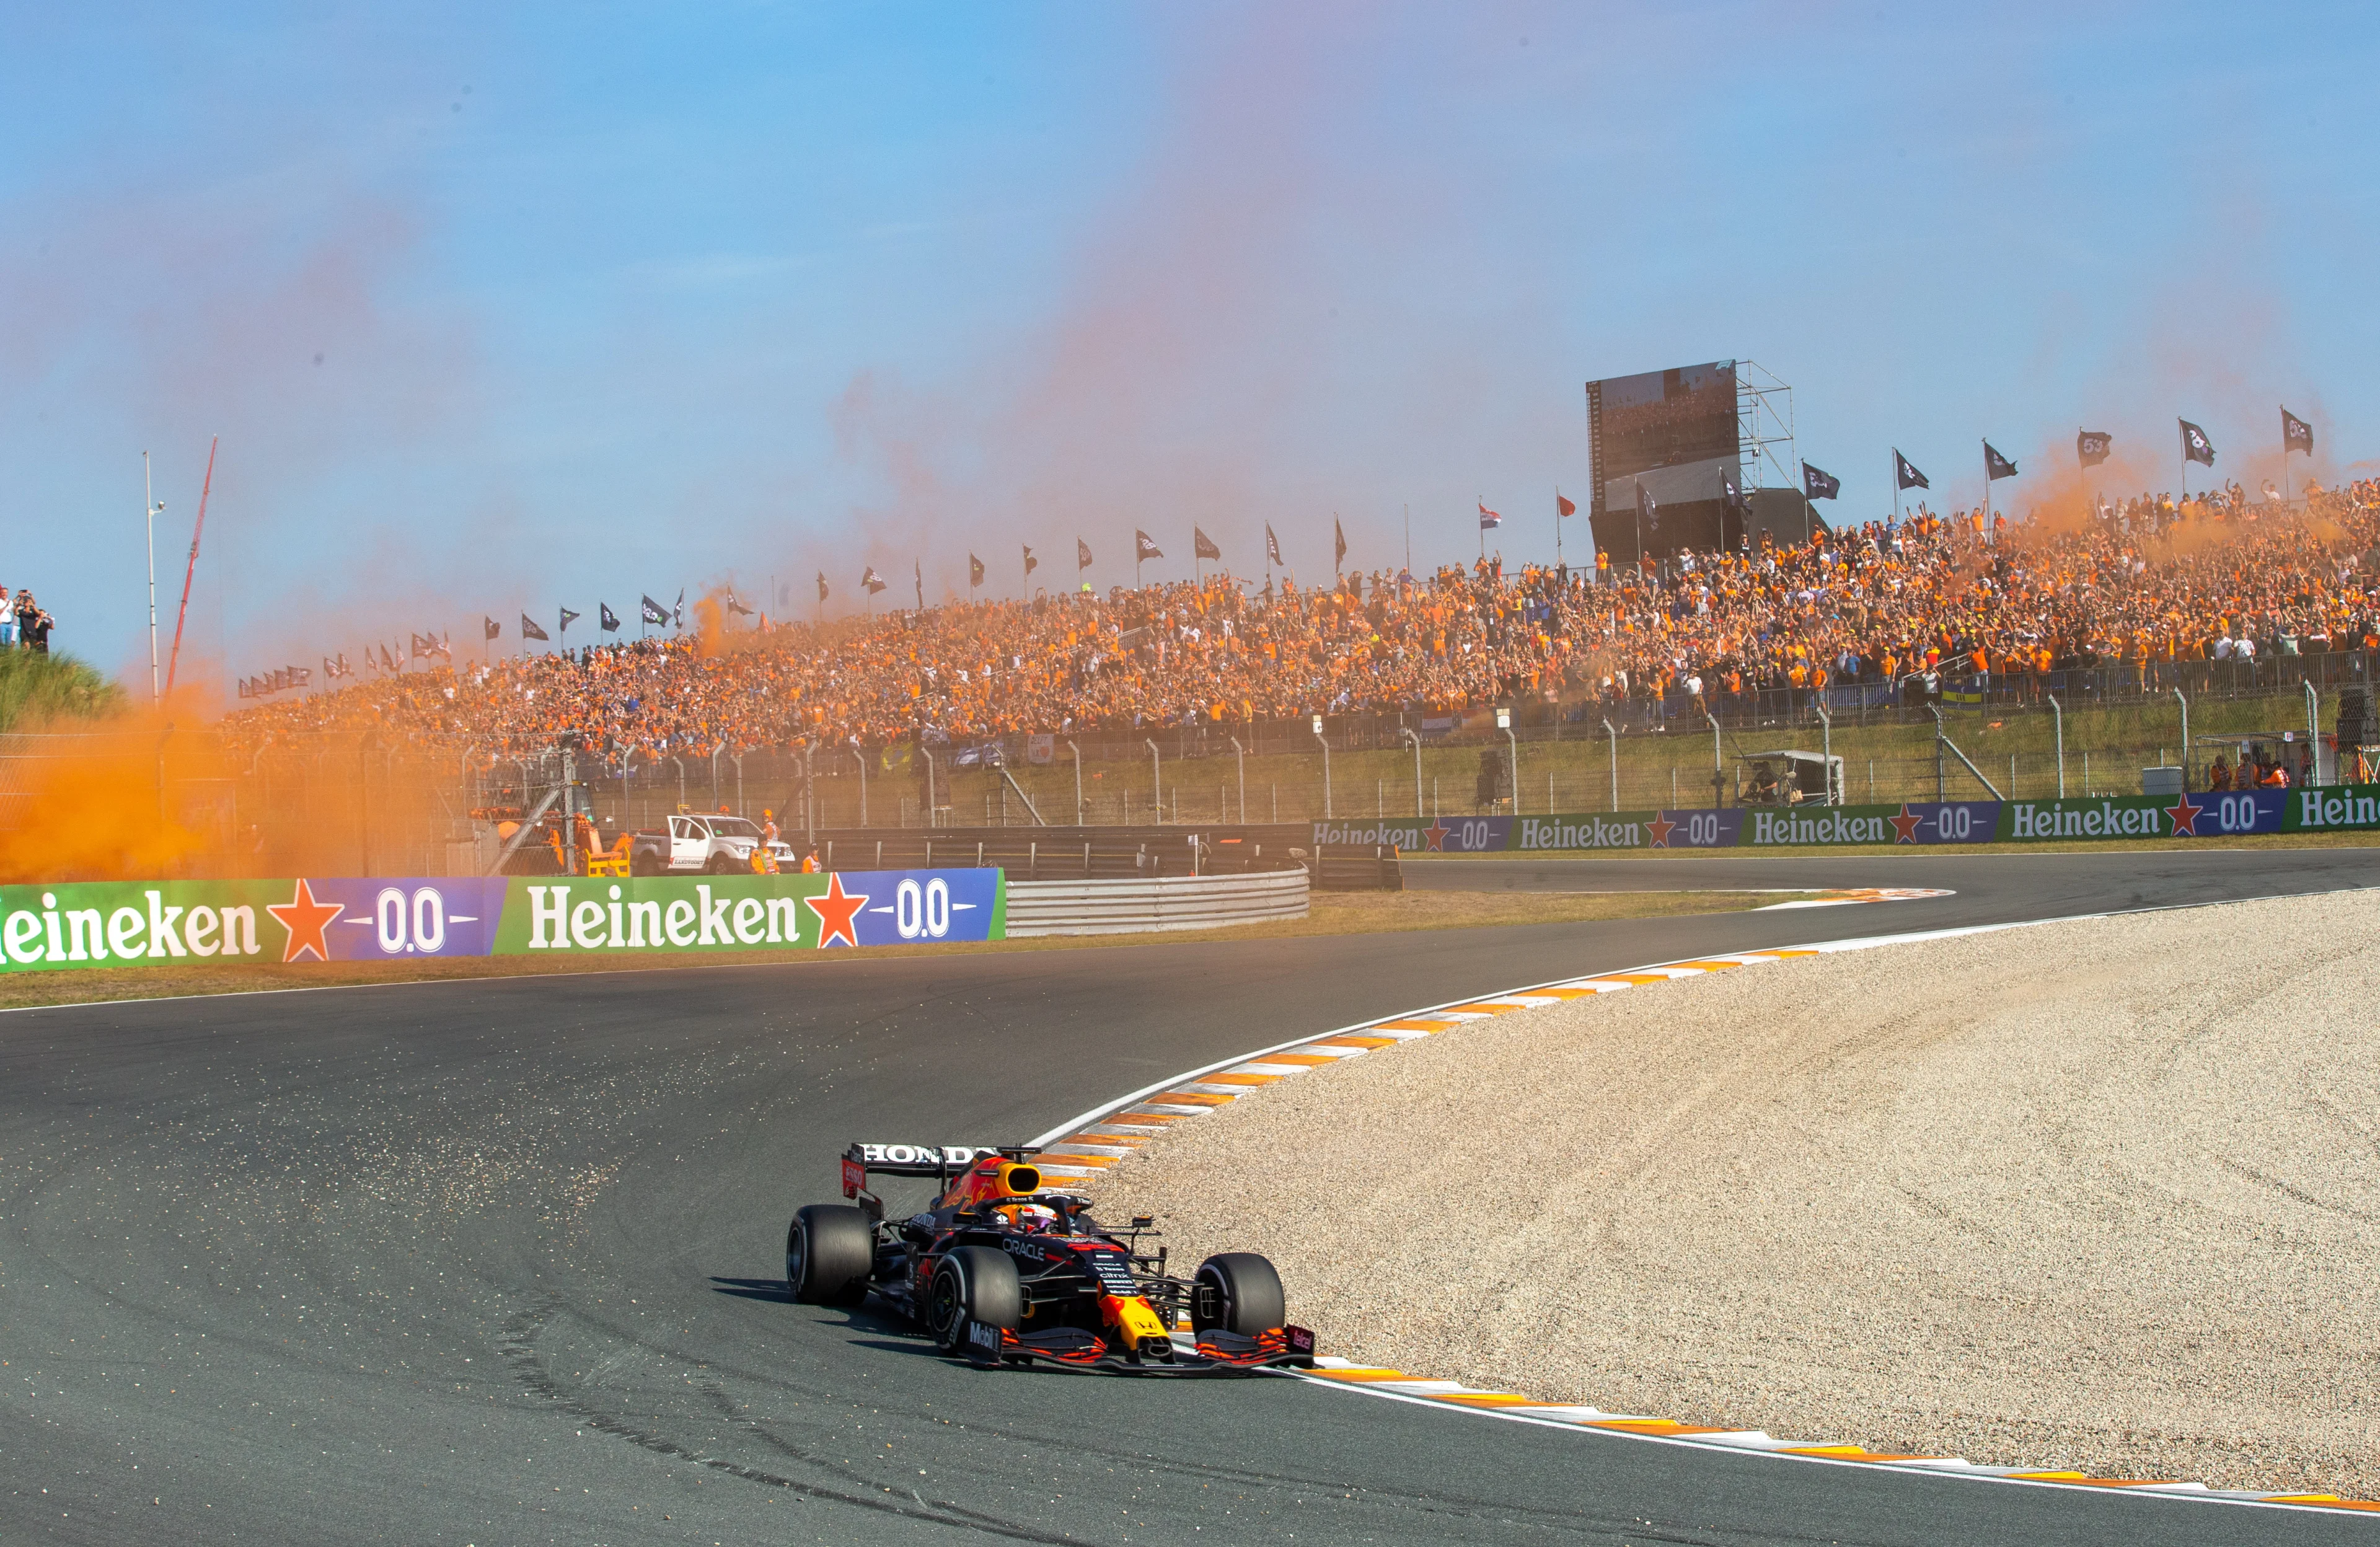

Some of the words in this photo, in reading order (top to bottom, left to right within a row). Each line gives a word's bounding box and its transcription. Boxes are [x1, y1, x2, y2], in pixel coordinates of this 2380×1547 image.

[1754, 808, 1885, 844] Heineken
[1938, 806, 1972, 839] 0.0
[2013, 801, 2160, 837] Heineken
[2220, 795, 2255, 831] 0.0
[2300, 788, 2380, 826] Hein
[635, 836, 662, 846] Rescue
[1313, 822, 1419, 850] Heineken
[1461, 820, 1488, 850] 0.0
[1520, 817, 1641, 849] Heineken
[1688, 813, 1719, 845] 0.0
[0, 890, 262, 963] eineken
[376, 886, 446, 954] 0.0
[527, 884, 800, 949] Heineken
[896, 878, 950, 938] 0.0
[845, 1166, 862, 1186] ESSO
[1003, 1238, 1045, 1262] ORACLE
[970, 1321, 993, 1349] Mobil
